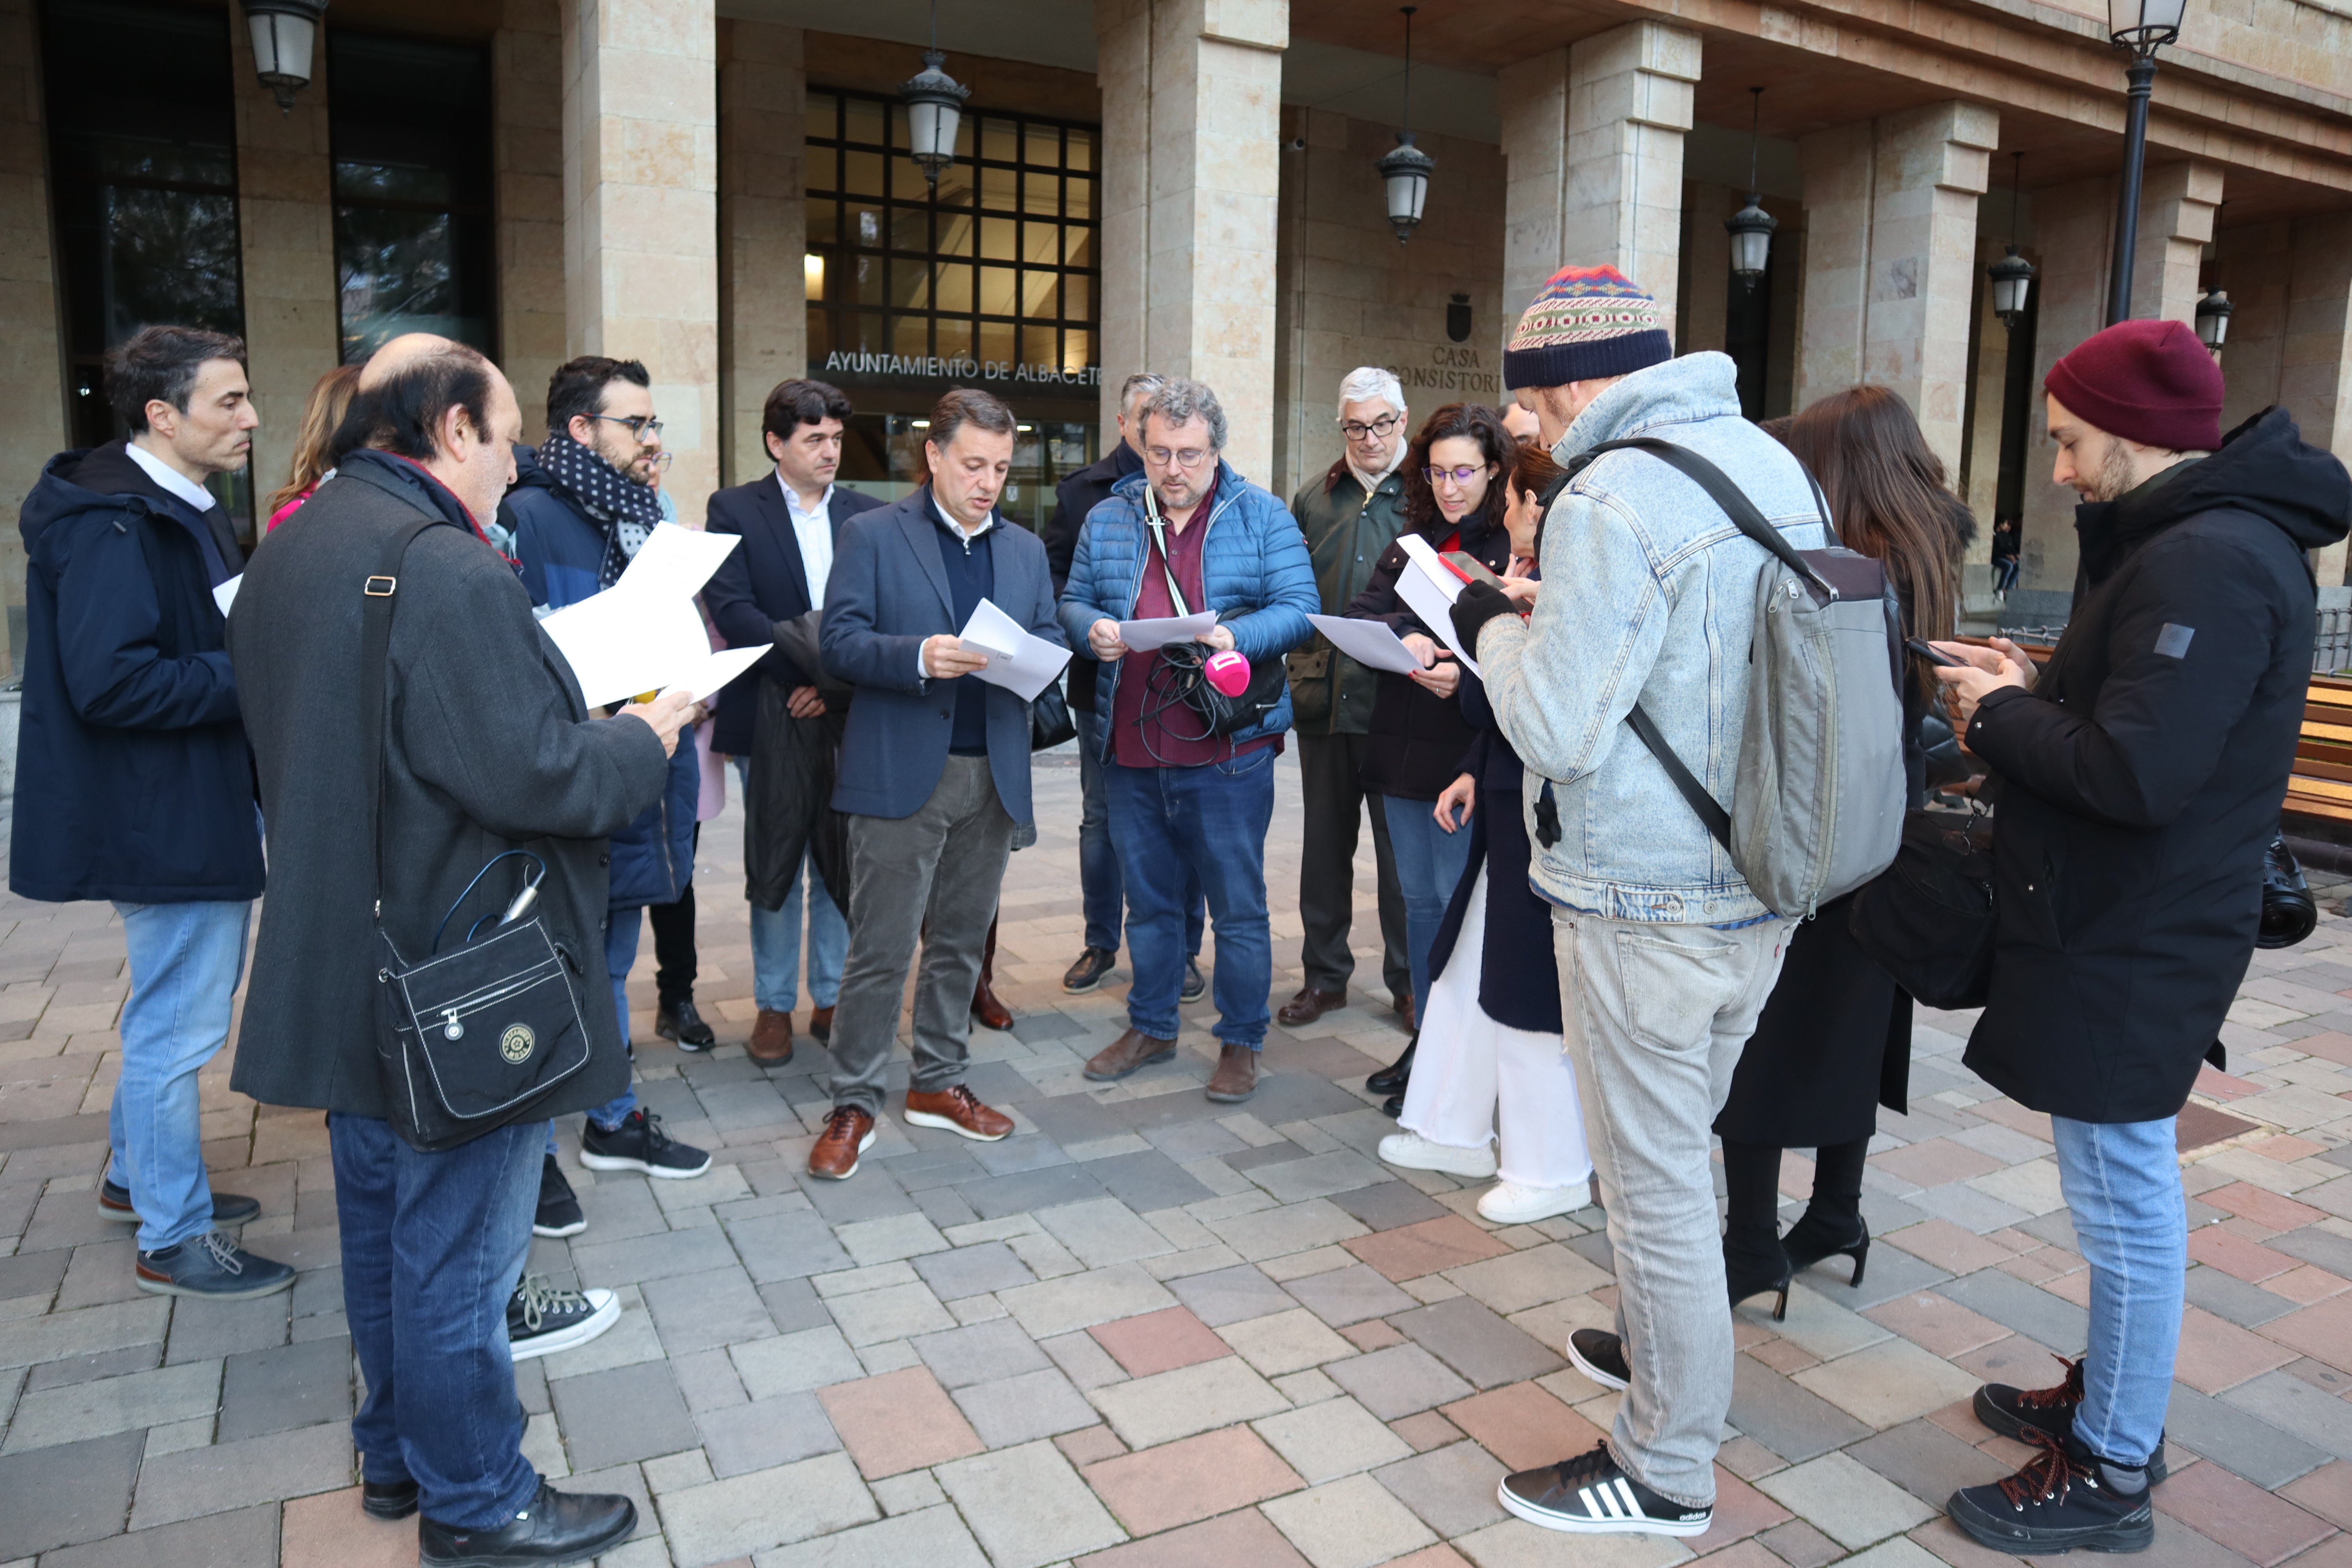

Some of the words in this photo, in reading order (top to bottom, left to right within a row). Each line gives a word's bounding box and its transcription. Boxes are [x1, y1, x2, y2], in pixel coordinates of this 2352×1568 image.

[825, 350, 979, 378] AYUNTAMIENTO
[984, 361, 1009, 379] DE
[1432, 346, 1480, 368] CASA
[1679, 1511, 1706, 1521] adidas
